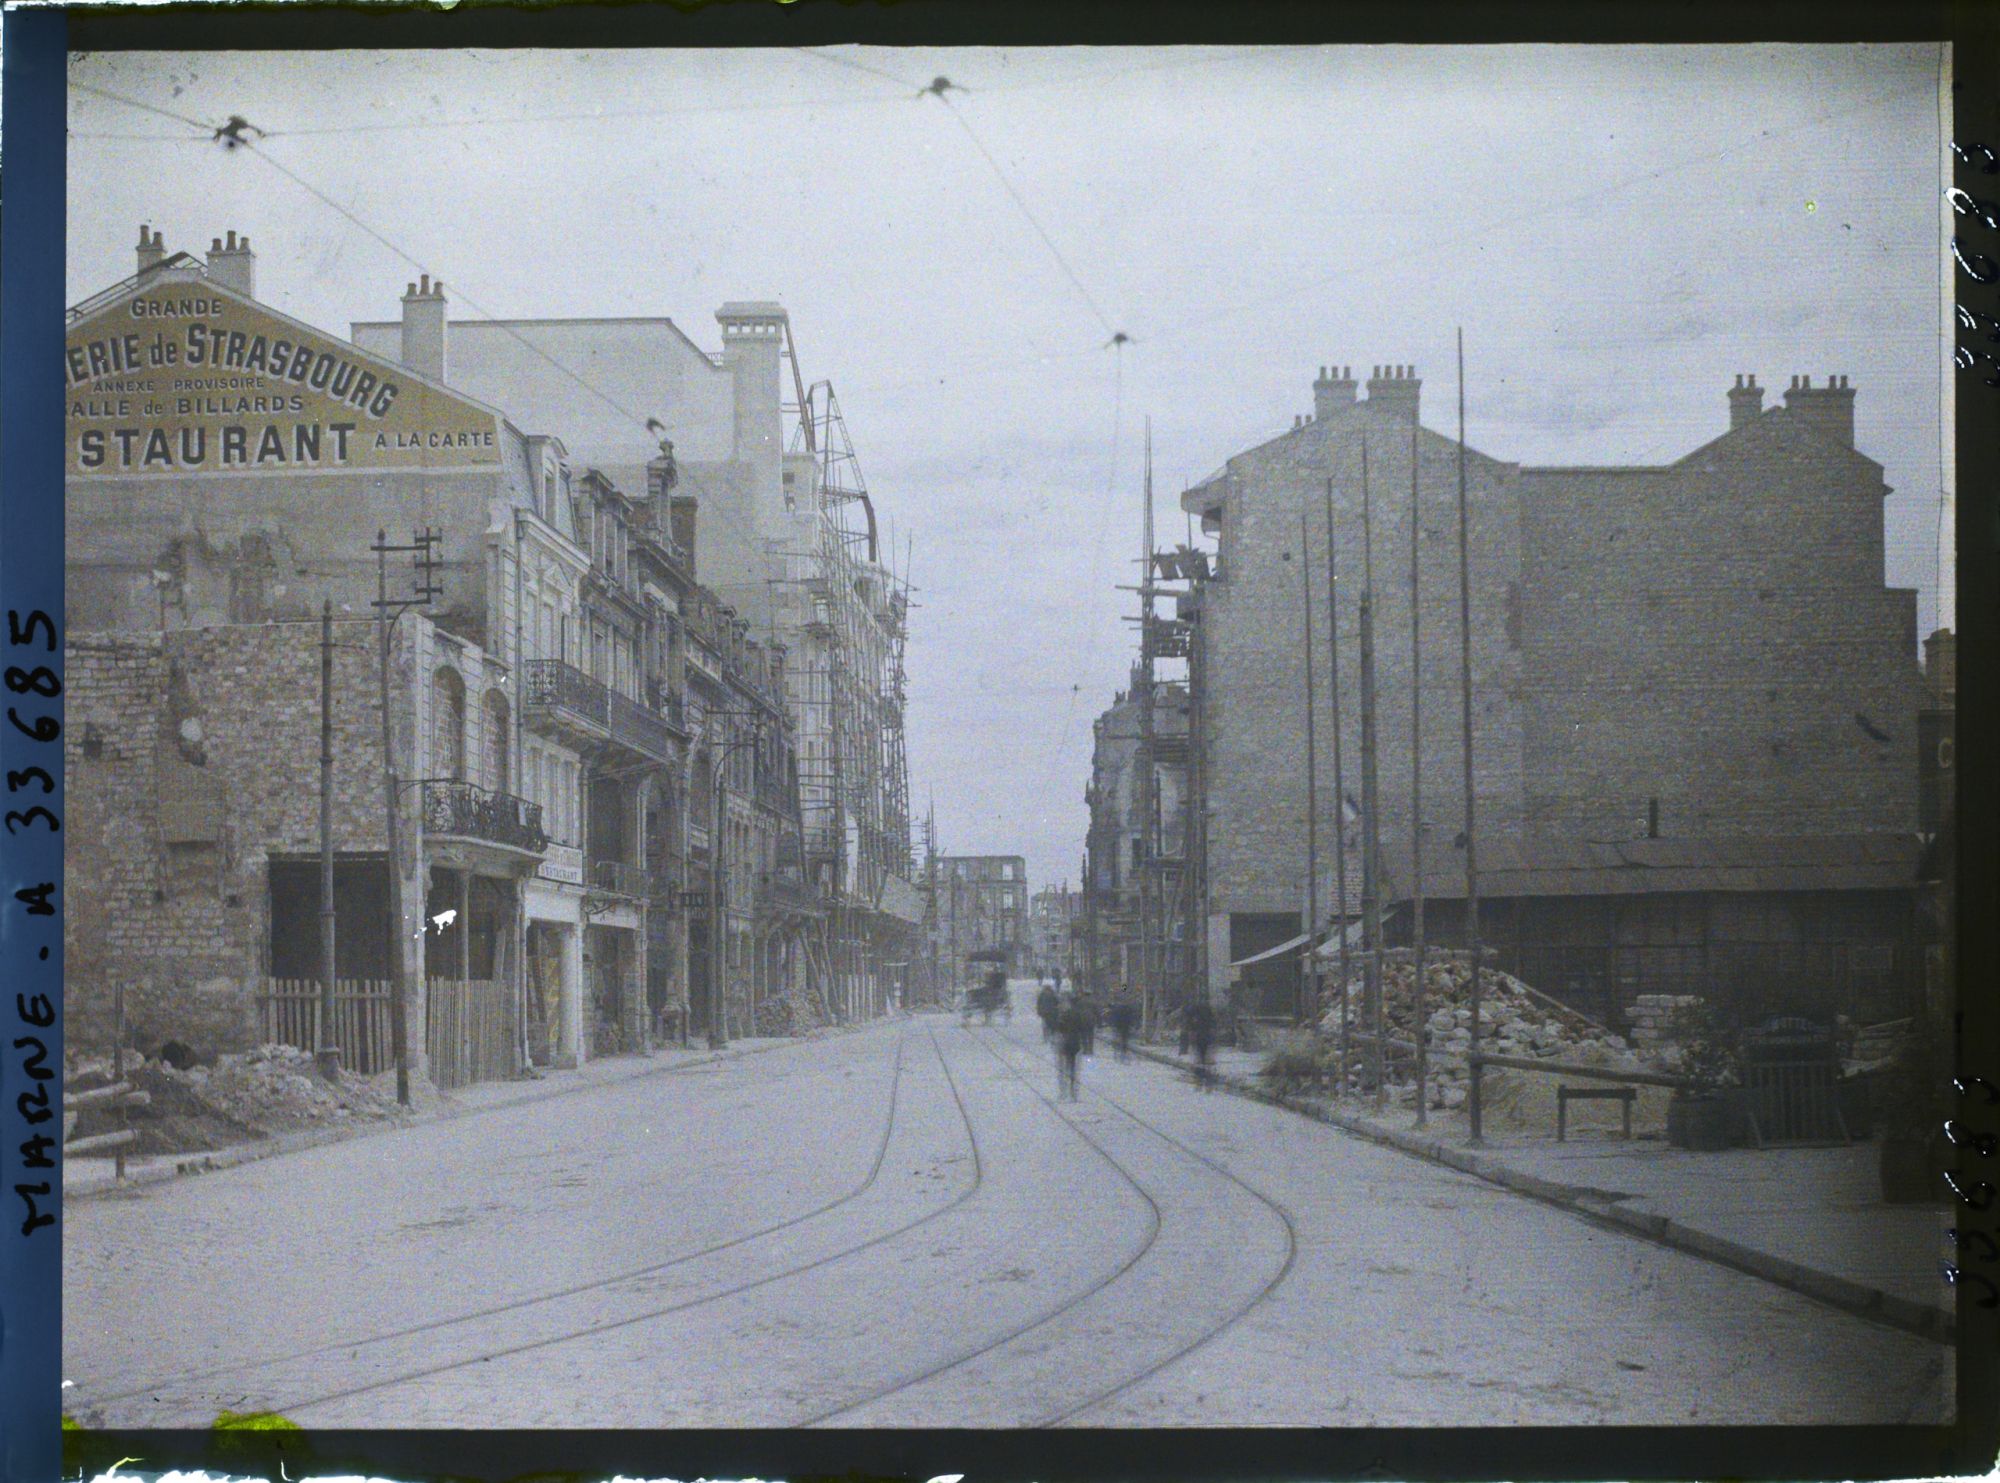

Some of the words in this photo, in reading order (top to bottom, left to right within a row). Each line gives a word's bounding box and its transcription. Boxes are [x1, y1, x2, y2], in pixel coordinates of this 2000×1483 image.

[130, 297, 223, 318] GRANDE
[65, 333, 142, 388] ERIE
[150, 333, 177, 367] de
[186, 322, 399, 418] STRASBOURG
[92, 381, 155, 393] ANNEXE
[174, 377, 265, 391] PROVISOIRE
[66, 400, 131, 416] ALLE
[144, 400, 163, 415] de
[178, 395, 304, 415] BILLARDS
[81, 422, 356, 467] STAURANT
[397, 432, 420, 447] LA
[429, 432, 493, 447] CARTE
[4, 609, 59, 836] 33685
[13, 992, 57, 1238] MARNE
